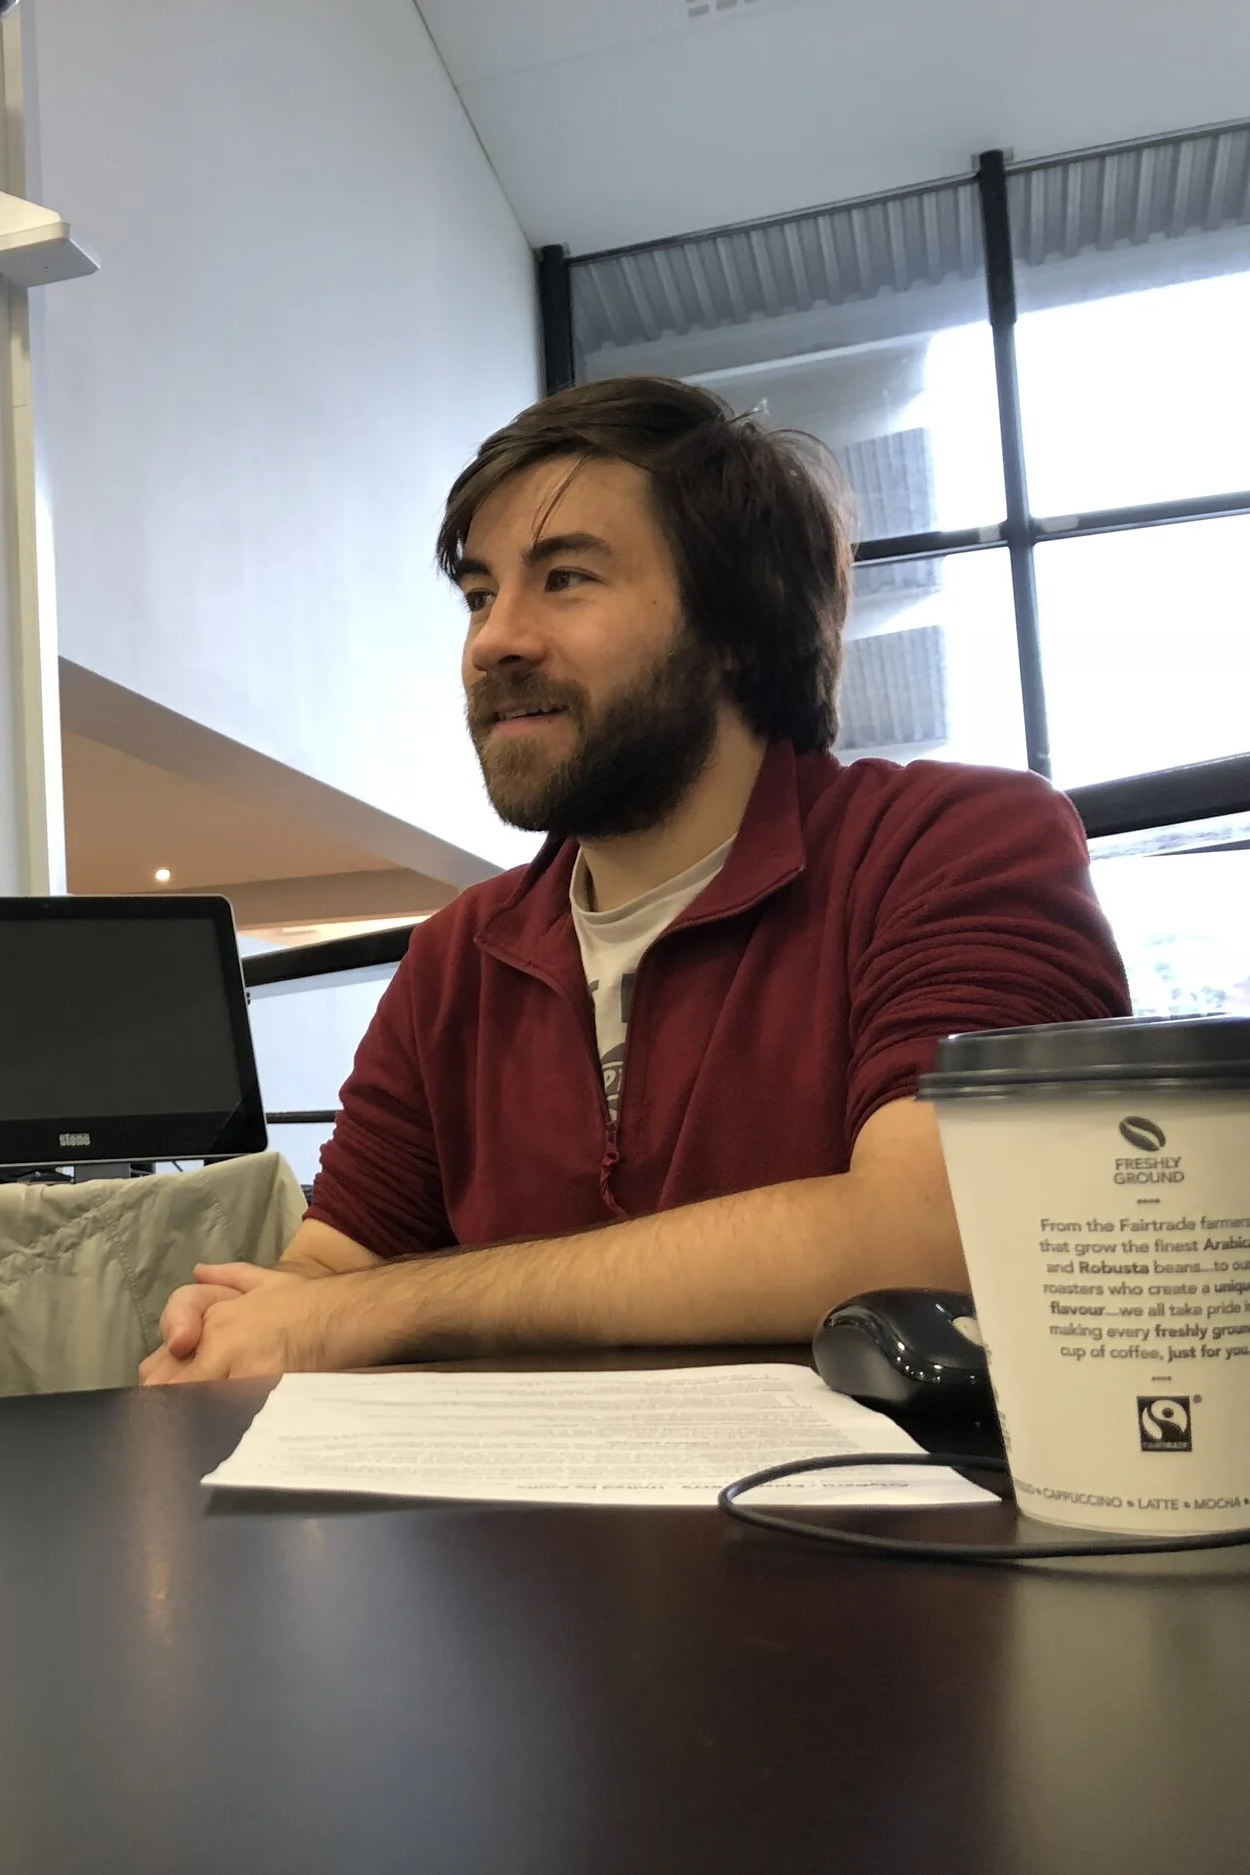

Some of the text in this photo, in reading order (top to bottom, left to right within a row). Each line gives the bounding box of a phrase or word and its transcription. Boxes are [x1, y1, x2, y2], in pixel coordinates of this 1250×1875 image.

[1115, 1156, 1181, 1170] FRESHLY
[1113, 1171, 1184, 1185] GROUND
[1040, 1218, 1082, 1232] From
[1085, 1218, 1115, 1232] the
[1119, 1217, 1196, 1232] Fairtrade
[1039, 1239, 1070, 1253] that
[1075, 1241, 1116, 1256] grow
[1121, 1239, 1149, 1253] the
[1155, 1239, 1198, 1253] finest
[1046, 1261, 1074, 1274] and
[1079, 1261, 1149, 1274] Robusta
[1043, 1282, 1104, 1295] roasters
[1108, 1282, 1143, 1295] who
[1147, 1283, 1198, 1295] create
[1202, 1284, 1210, 1294] a
[1147, 1303, 1165, 1316] all
[1169, 1302, 1202, 1316] take
[1207, 1300, 1241, 1319] pride
[1049, 1324, 1102, 1340] making
[1107, 1327, 1149, 1341] every
[1154, 1323, 1208, 1340] freshly
[1060, 1346, 1086, 1360] cup
[1090, 1344, 1106, 1358] of
[1110, 1344, 1164, 1360] coffee,
[1167, 1345, 1197, 1362] just
[1200, 1343, 1222, 1358] for
[1042, 1487, 1241, 1510] CAPPUCCINO LATTE MOCHA
